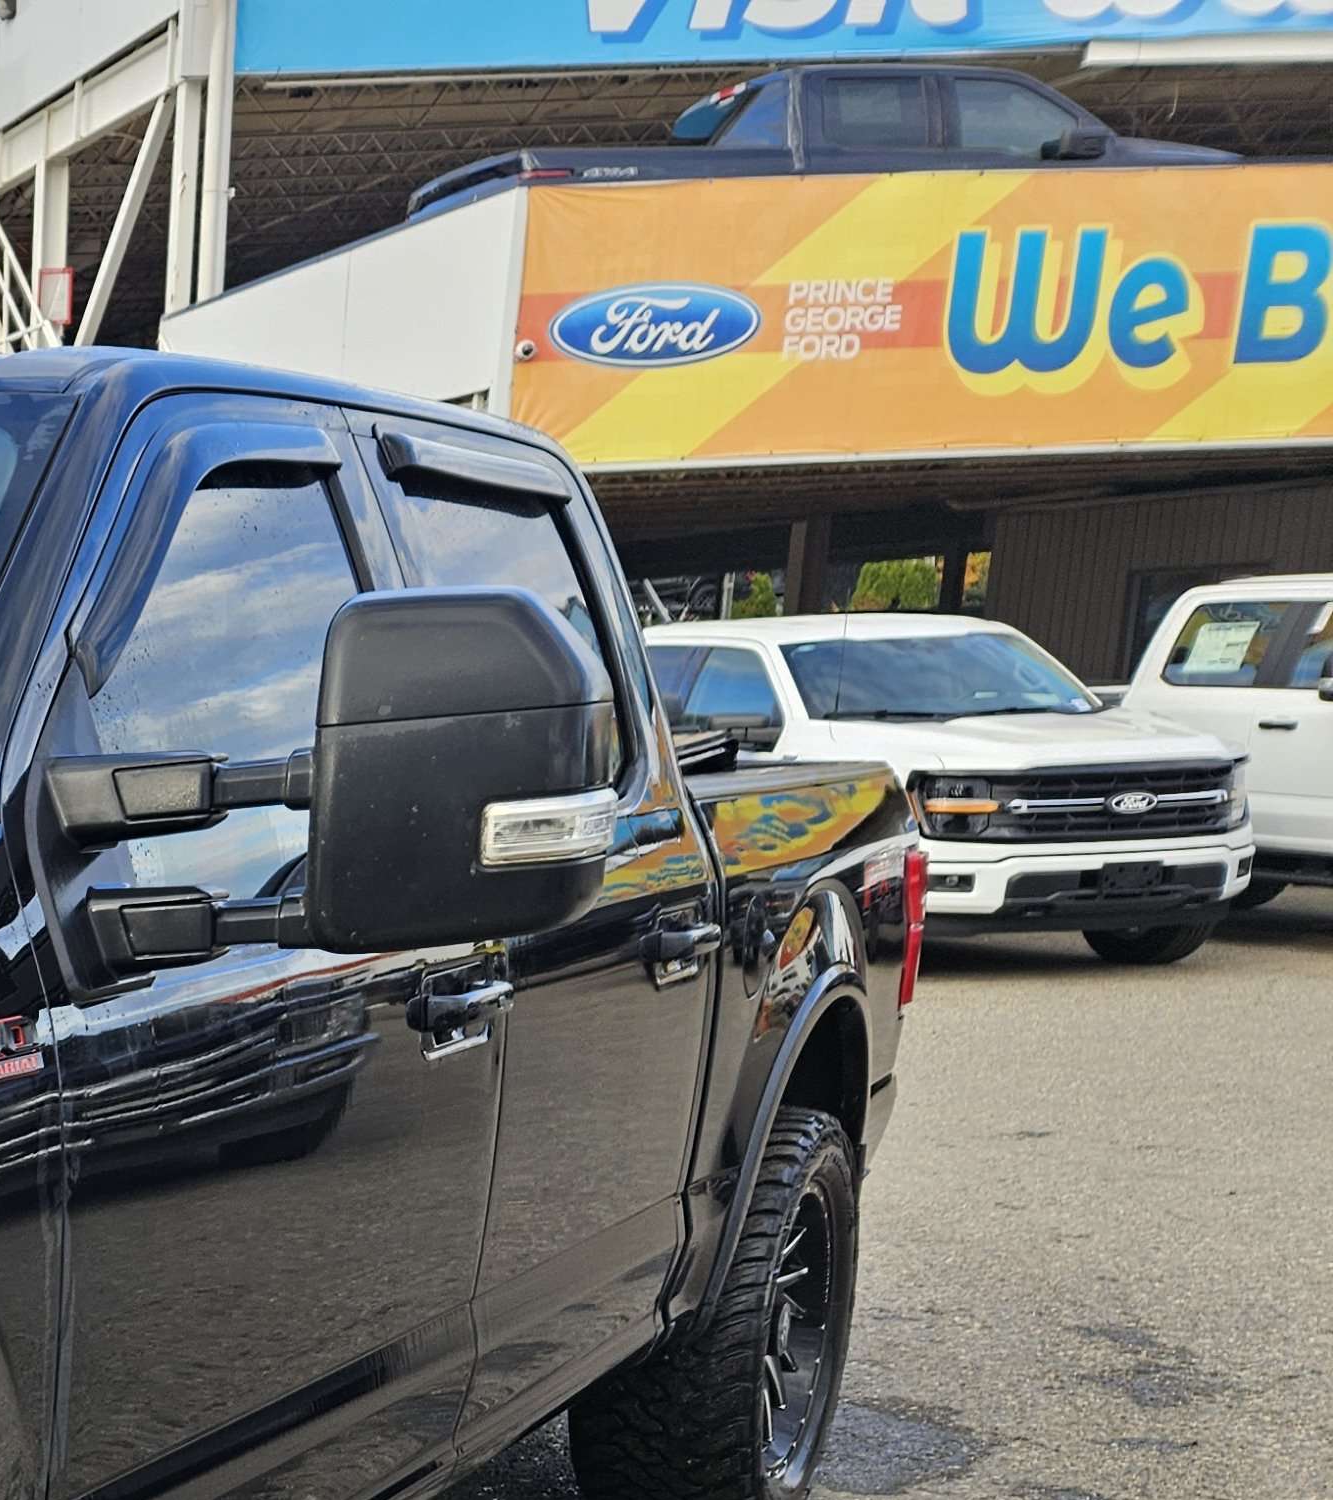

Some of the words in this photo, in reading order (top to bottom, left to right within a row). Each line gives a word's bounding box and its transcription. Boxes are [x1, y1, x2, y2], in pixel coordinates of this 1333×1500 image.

[788, 278, 894, 305] PRINCE
[945, 226, 1190, 376] We
[590, 295, 721, 355] Ford
[784, 305, 903, 333] GEORGE
[781, 335, 862, 361] FORD
